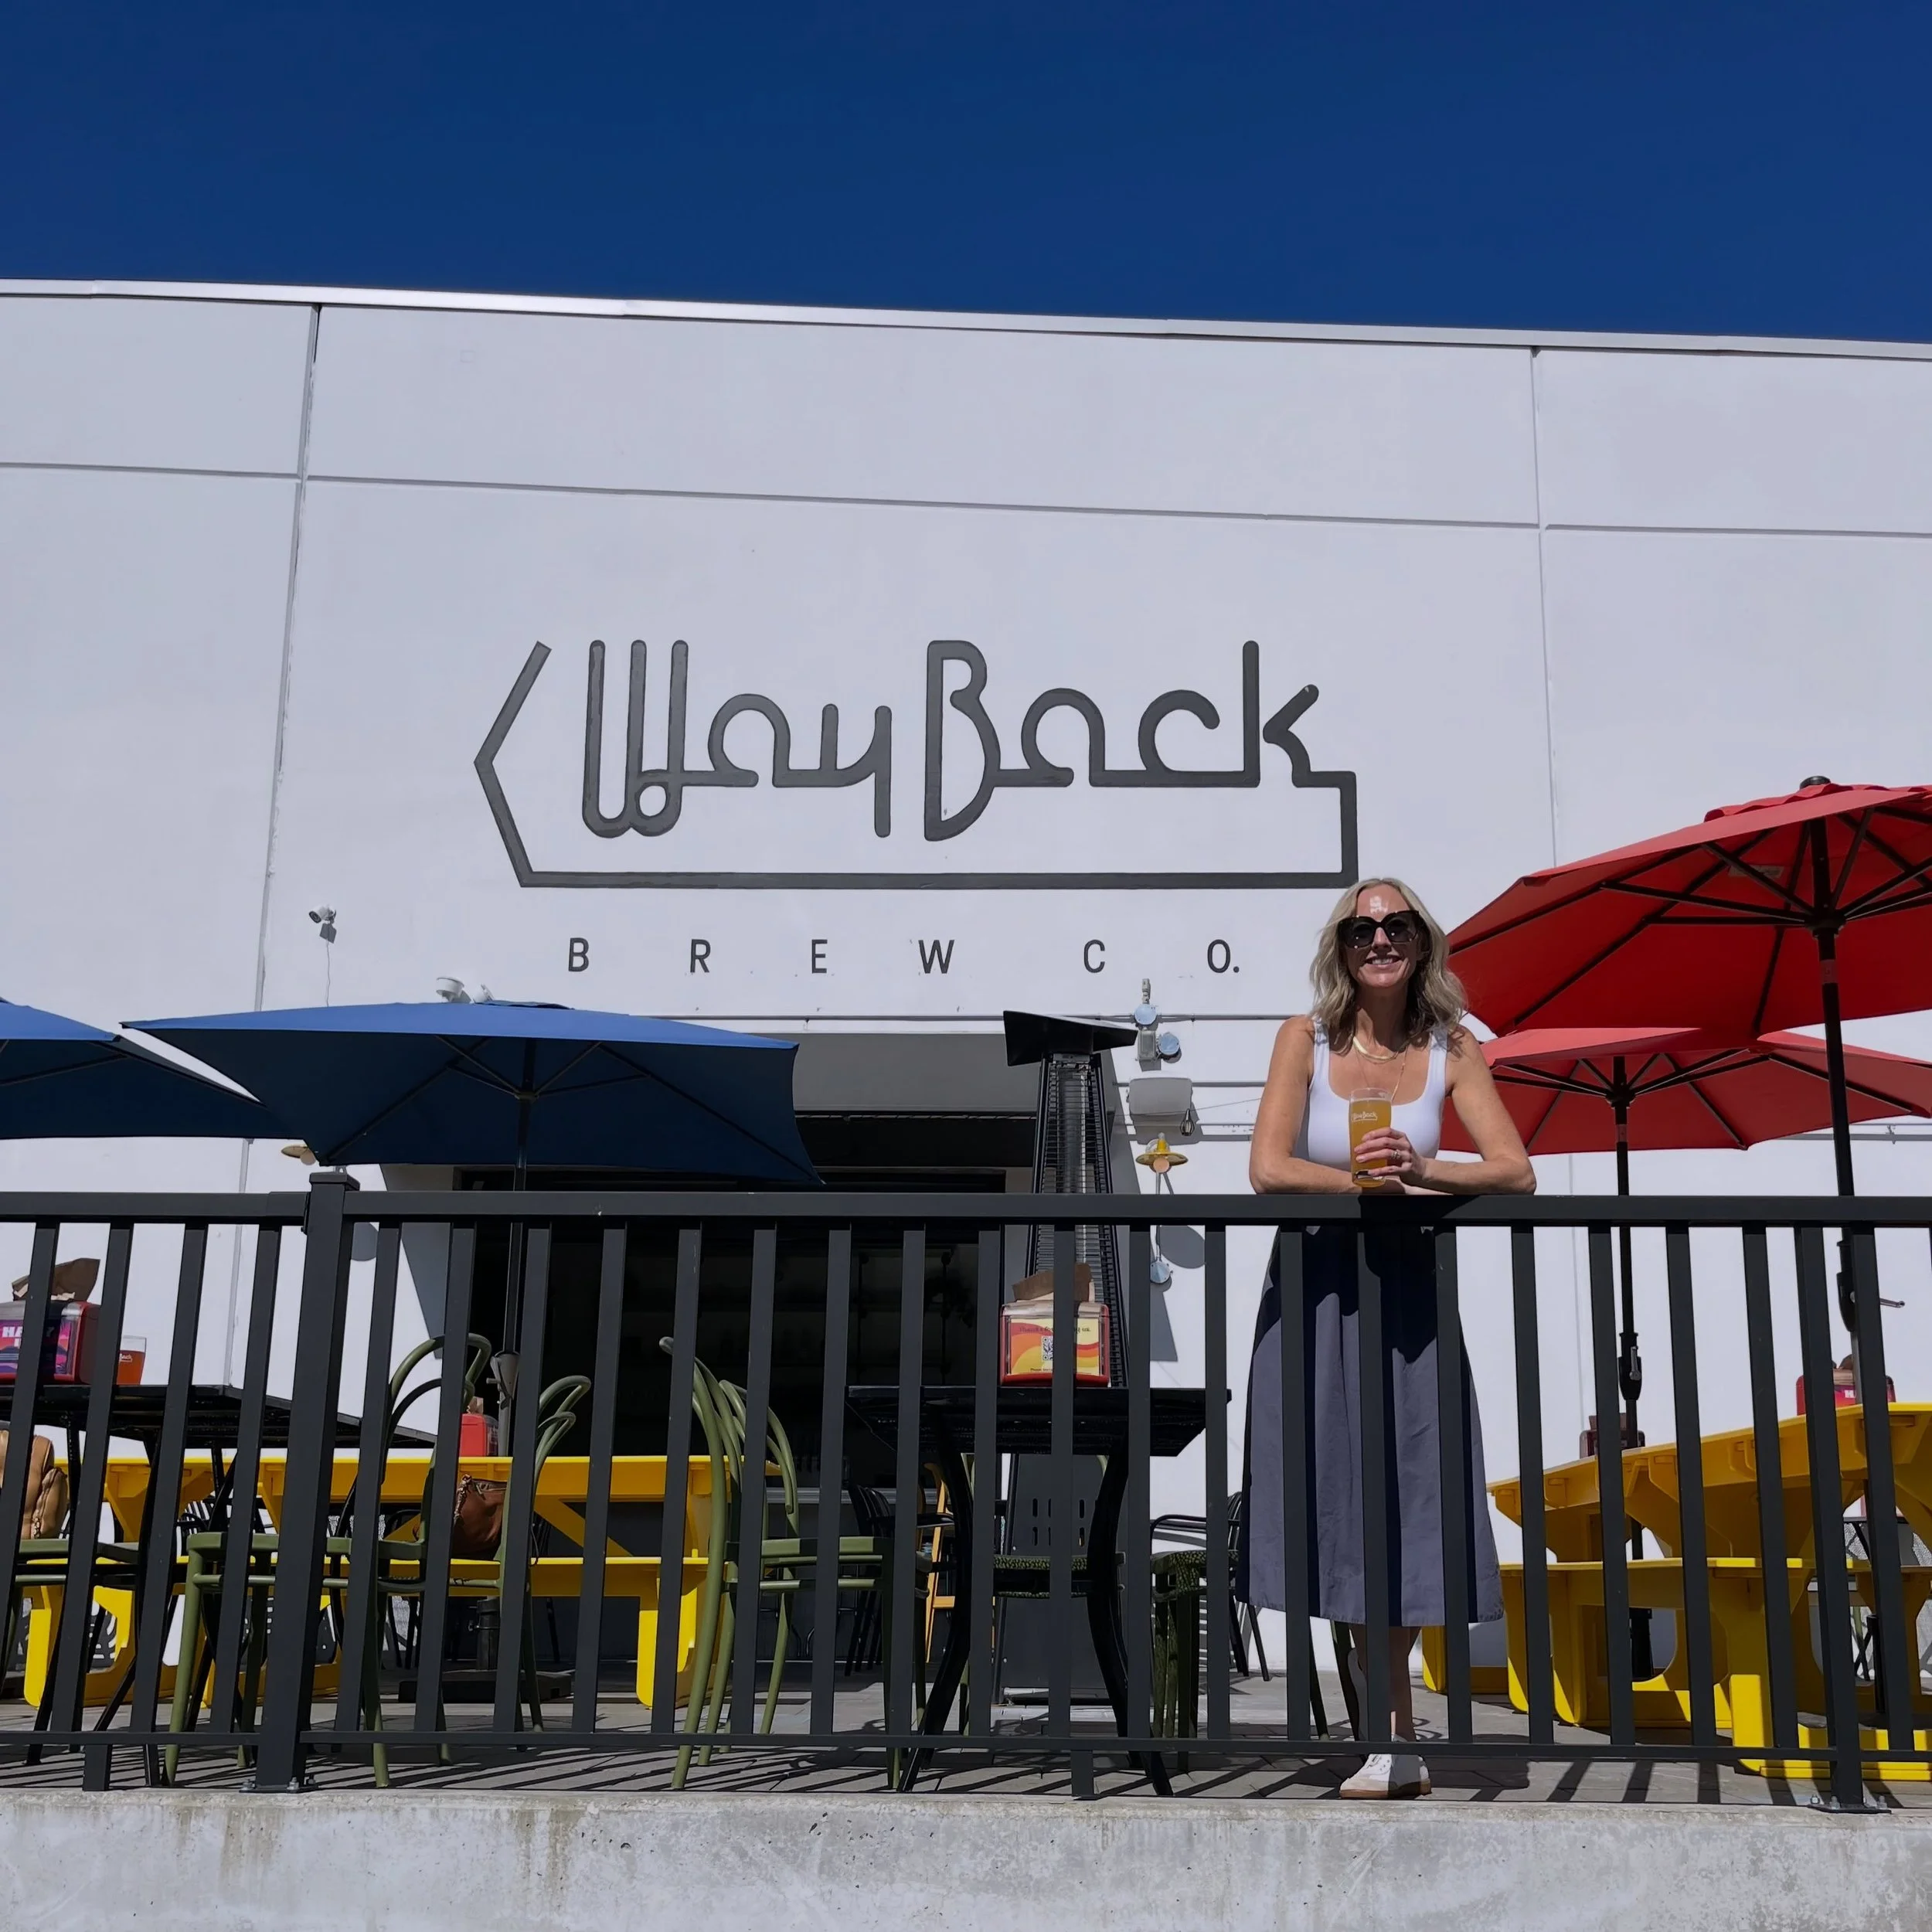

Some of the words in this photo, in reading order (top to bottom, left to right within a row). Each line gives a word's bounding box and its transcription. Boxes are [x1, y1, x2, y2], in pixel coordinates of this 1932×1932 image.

[581, 639, 1319, 842] WayBack
[568, 937, 956, 975] BREW
[1083, 939, 1240, 974] CO.
